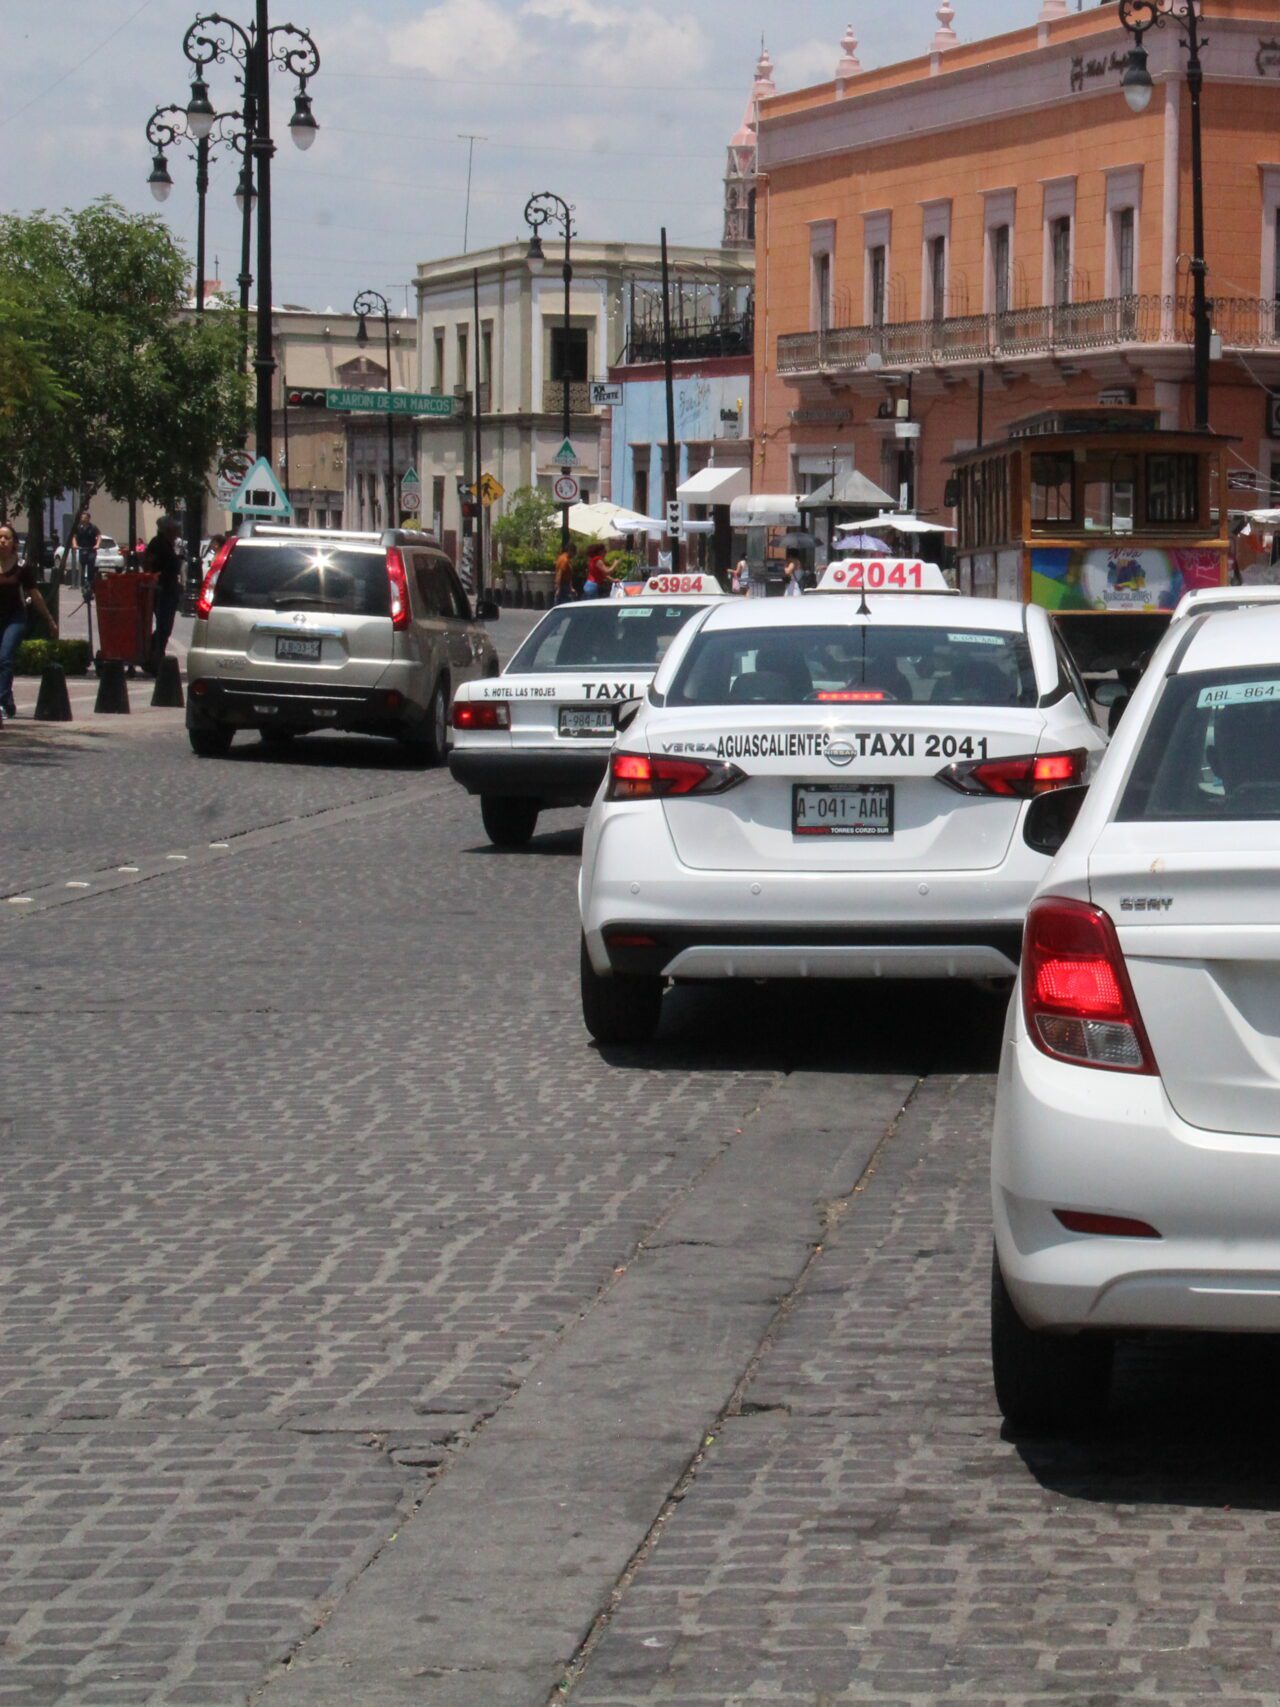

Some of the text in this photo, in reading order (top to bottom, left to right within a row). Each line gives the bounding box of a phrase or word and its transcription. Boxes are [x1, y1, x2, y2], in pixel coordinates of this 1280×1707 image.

[339, 394, 450, 412] JARDIN DE SN MARCOS
[847, 562, 923, 588] 2041
[658, 576, 703, 593] 3984
[492, 688, 513, 697] HOTEL
[515, 688, 528, 696] LAS
[530, 687, 556, 697] TROJES
[582, 683, 635, 699] TAXI
[716, 733, 830, 758] AGUASCALIENTES
[855, 733, 988, 759] TAXI 2041
